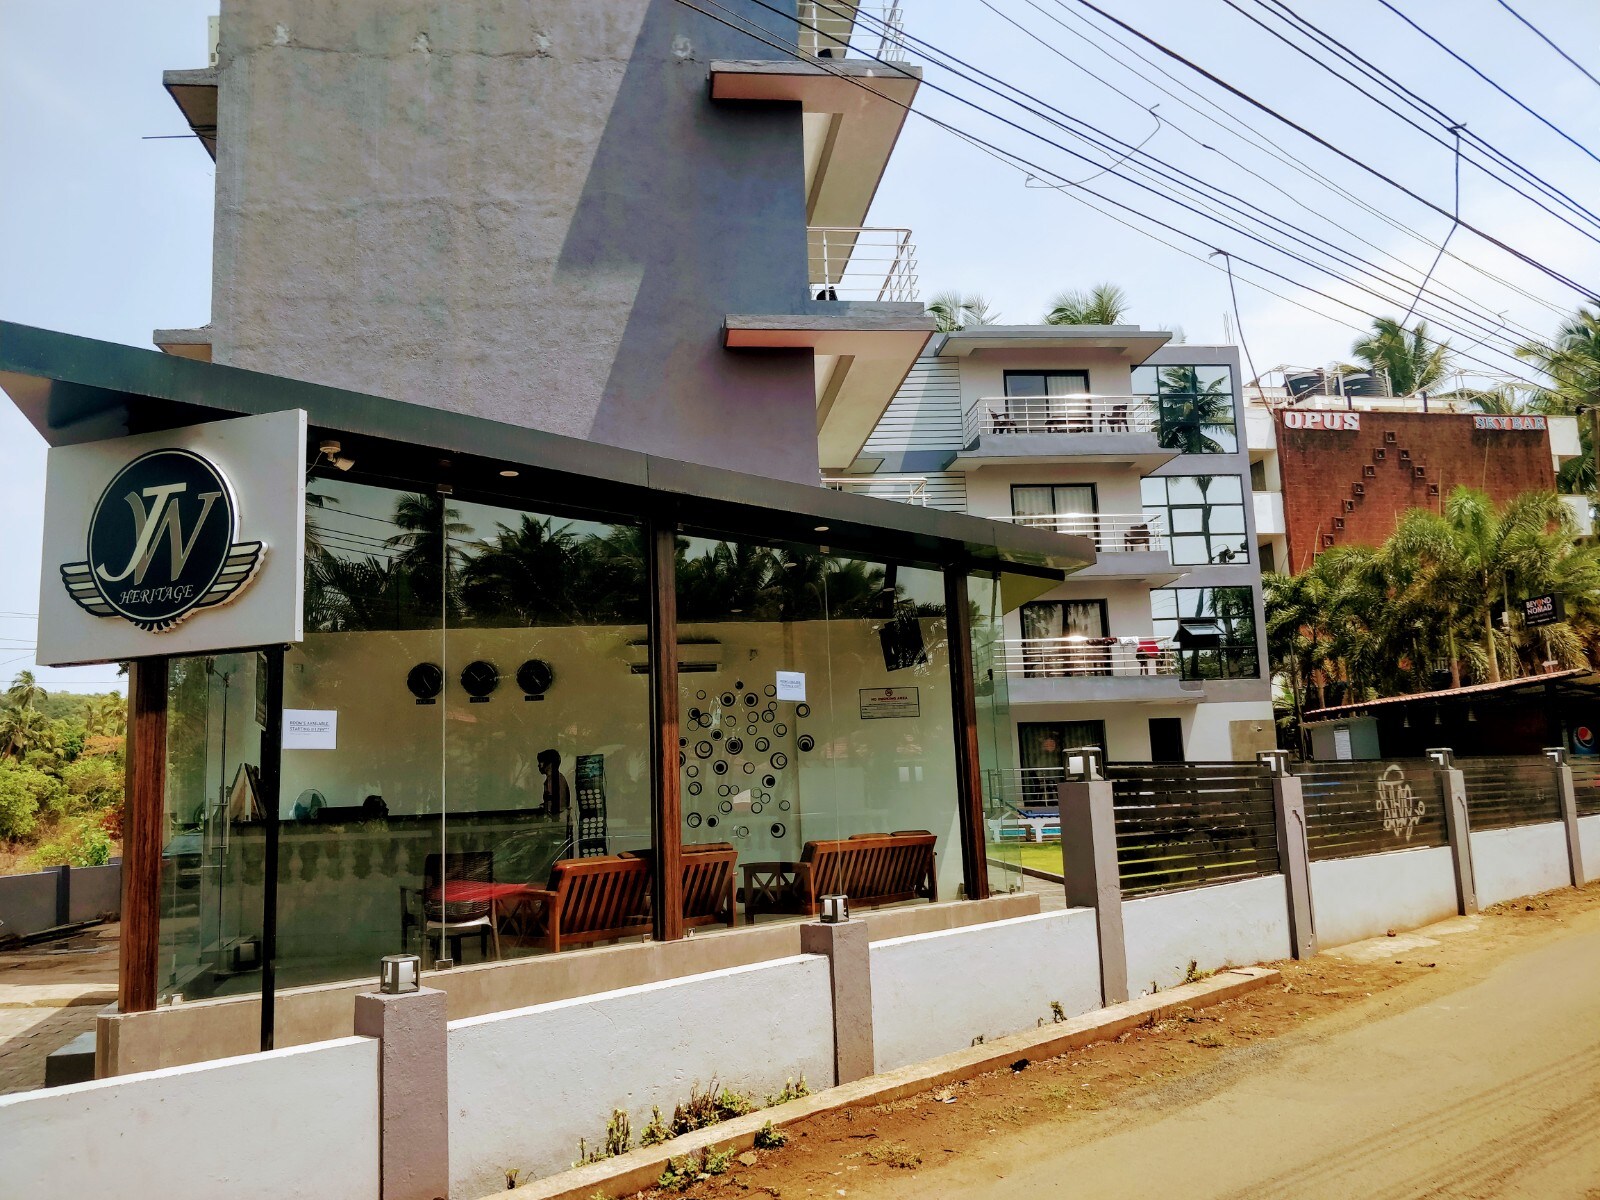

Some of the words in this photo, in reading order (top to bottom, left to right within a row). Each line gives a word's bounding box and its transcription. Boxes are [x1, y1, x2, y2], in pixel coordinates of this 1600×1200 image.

[1284, 411, 1360, 430] OPUS
[119, 584, 194, 605] HERITAGE
[1526, 597, 1551, 608] BEYOND
[1527, 604, 1552, 615] NOMAD
